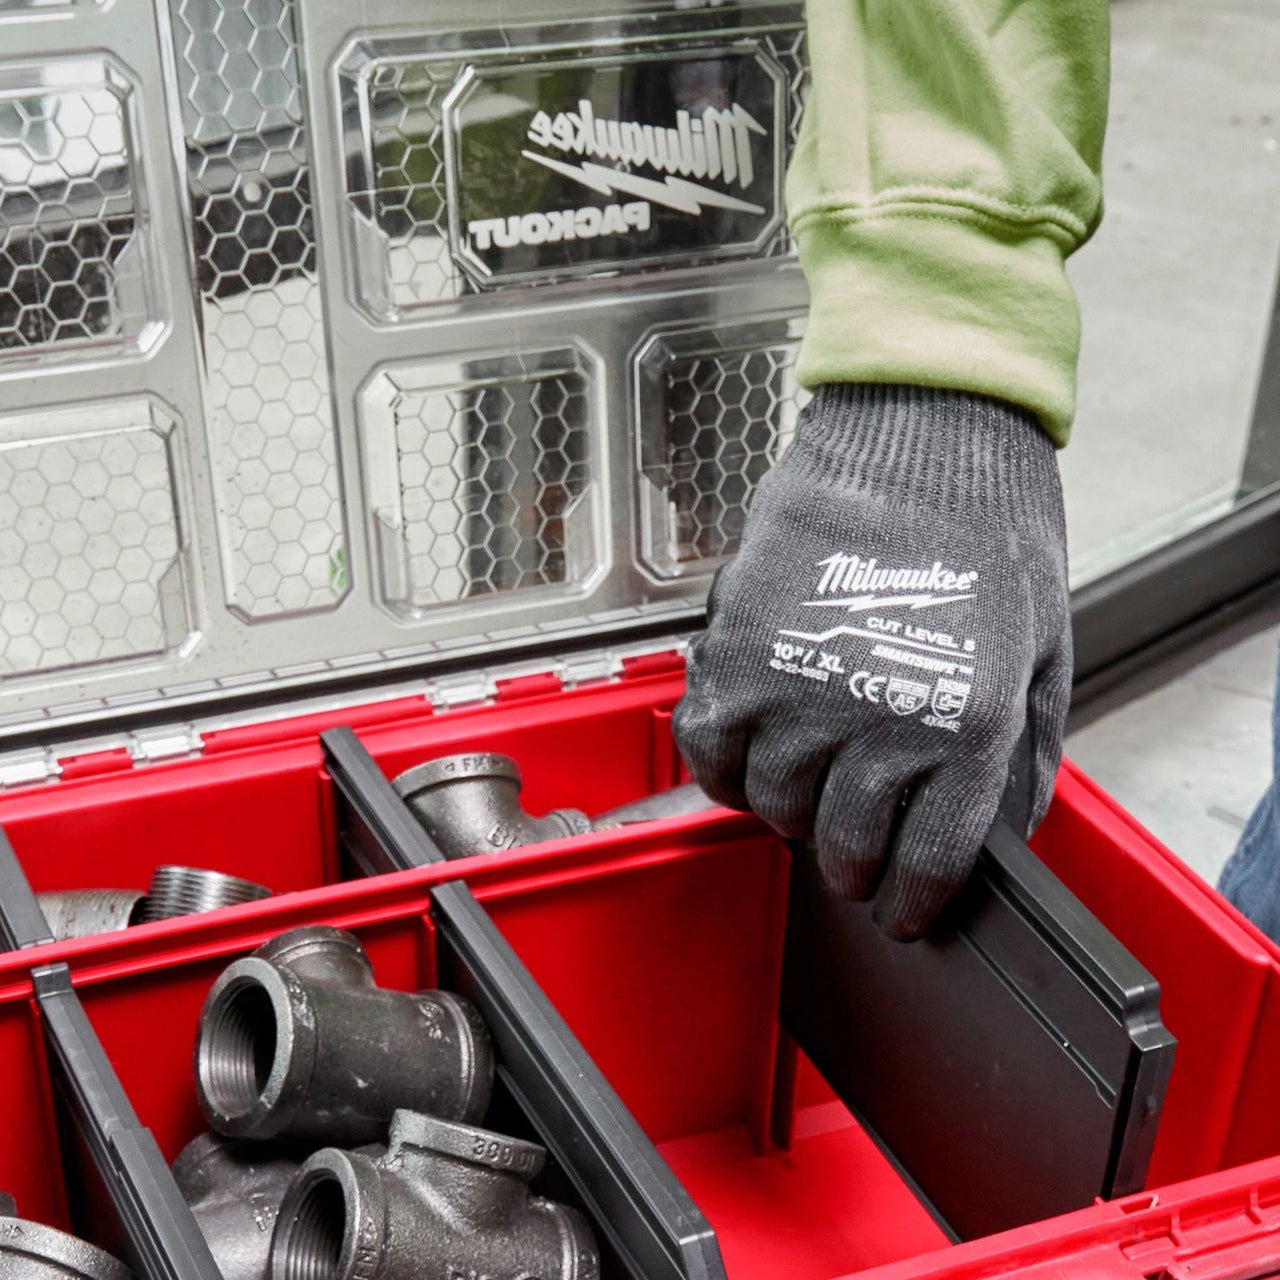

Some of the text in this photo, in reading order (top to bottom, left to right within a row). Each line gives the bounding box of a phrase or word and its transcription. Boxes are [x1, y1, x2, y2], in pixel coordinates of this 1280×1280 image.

[817, 552, 975, 594] Milwaukee
[867, 617, 975, 651] CUT LEVEL 5
[816, 651, 844, 674] XL
[893, 693, 916, 709] A5
